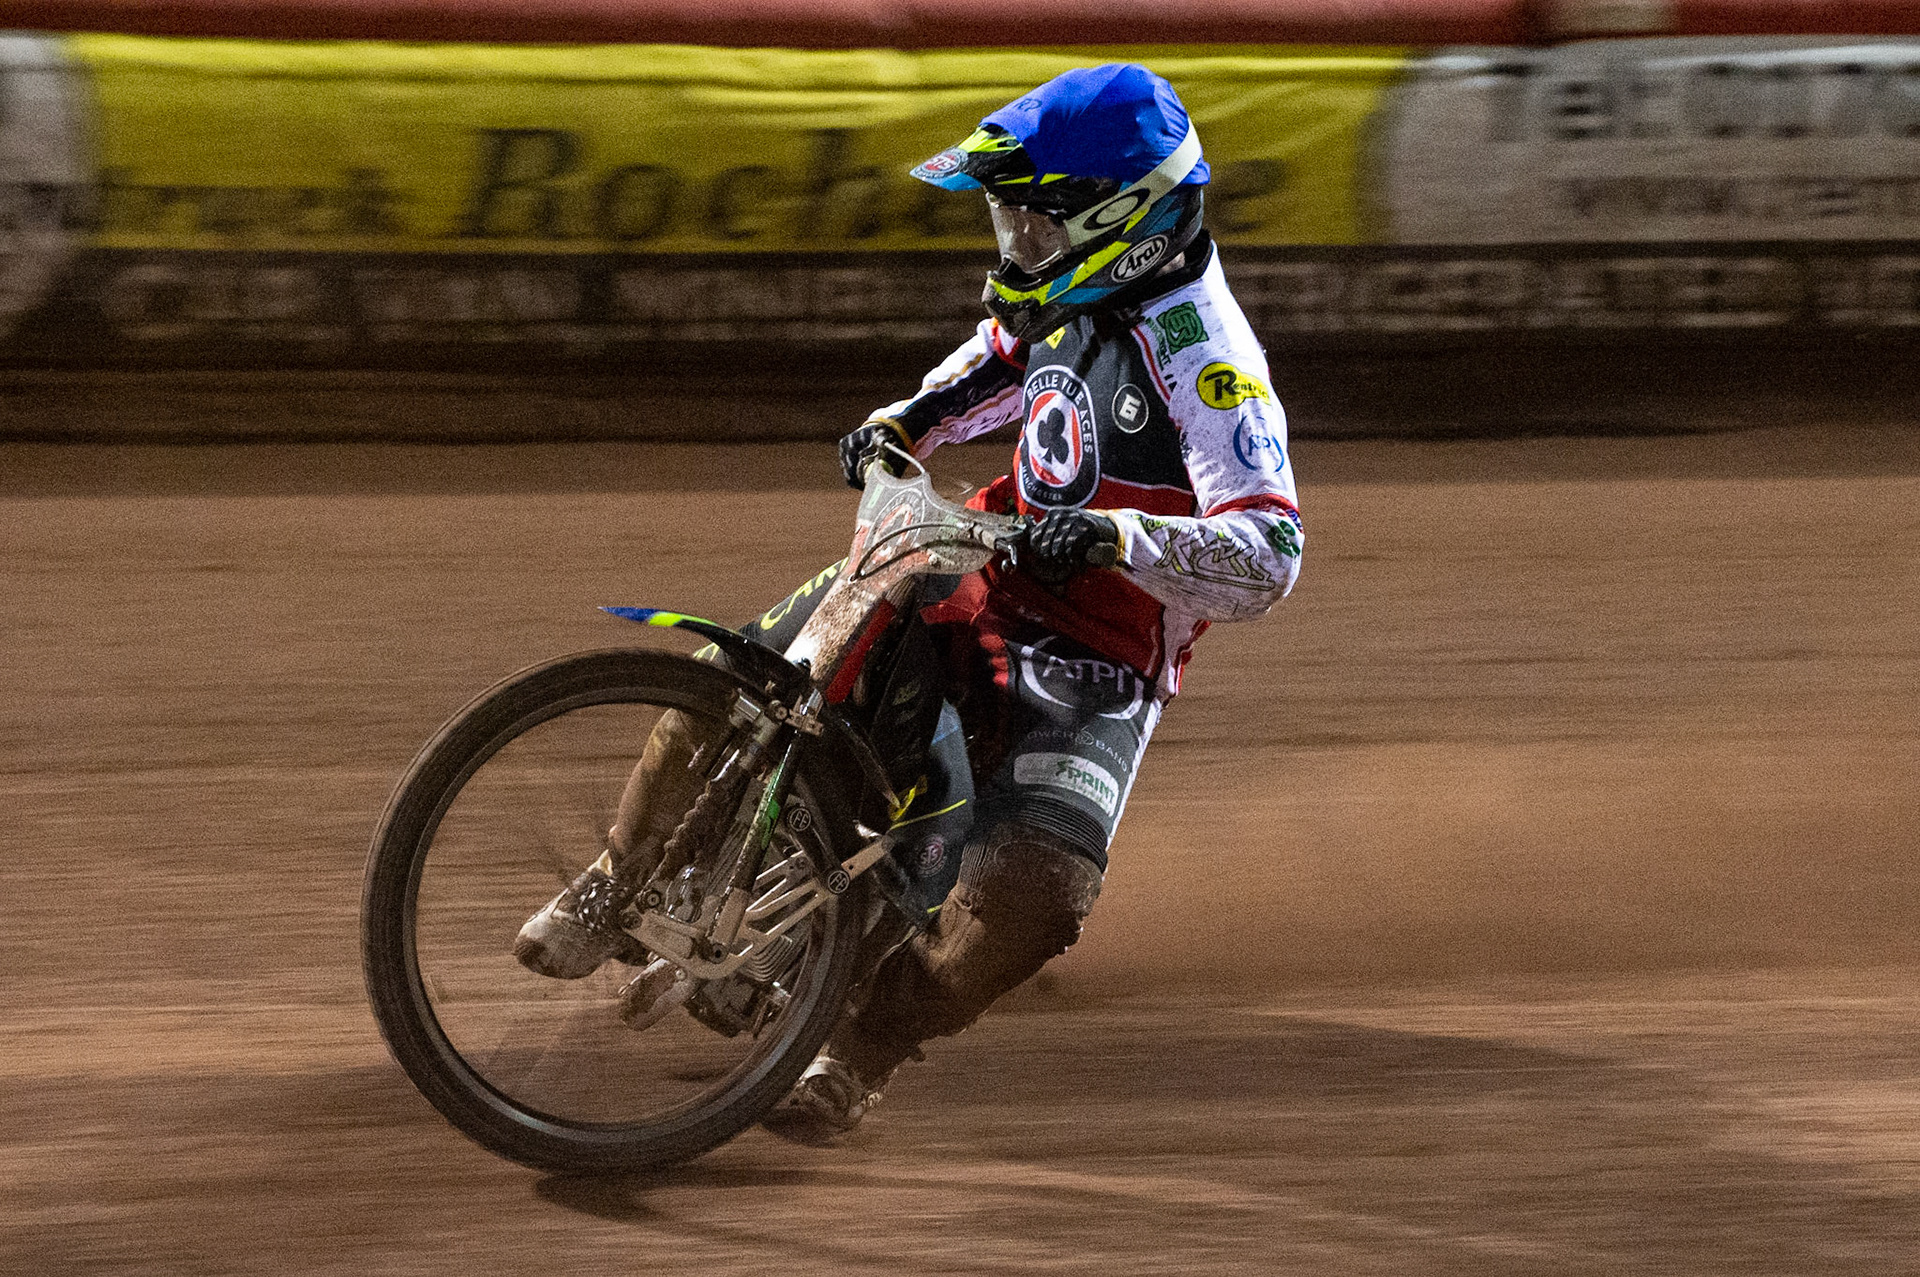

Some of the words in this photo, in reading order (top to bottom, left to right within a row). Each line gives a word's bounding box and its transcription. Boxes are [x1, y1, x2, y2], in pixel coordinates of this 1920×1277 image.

[1121, 239, 1161, 279] Arai
[1026, 374, 1060, 401] BELLE
[1079, 409, 1094, 455] ACES
[1118, 393, 1142, 421] 6
